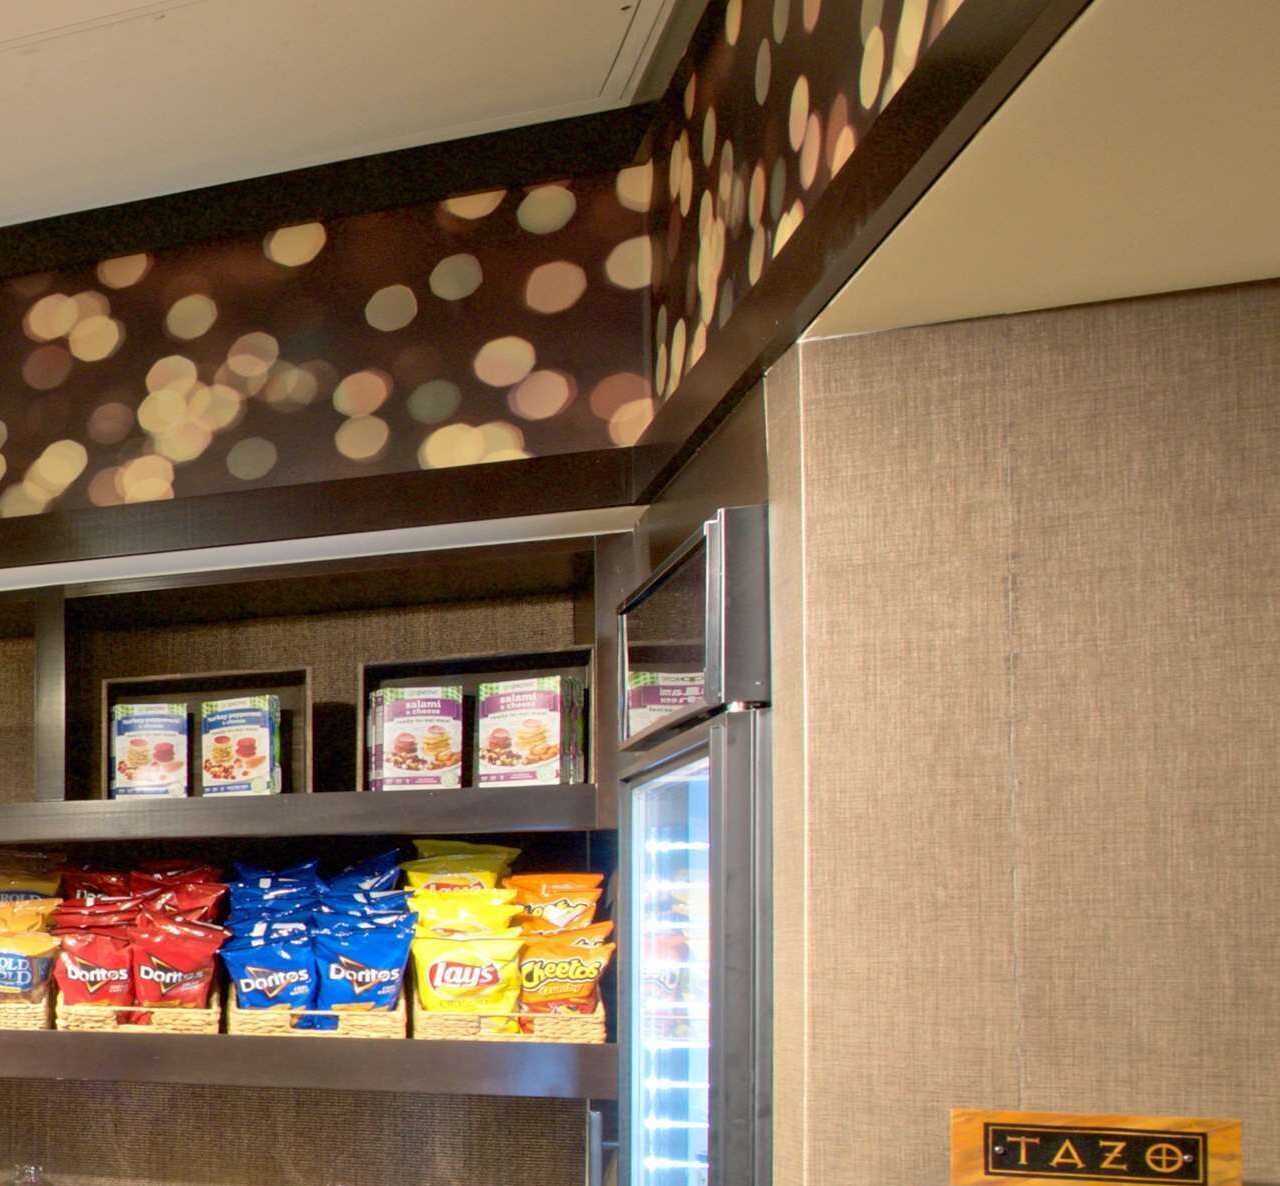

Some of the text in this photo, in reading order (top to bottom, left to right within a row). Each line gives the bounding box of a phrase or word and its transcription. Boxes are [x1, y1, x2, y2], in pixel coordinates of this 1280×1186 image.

[405, 699, 442, 709] salami
[499, 692, 537, 704] salami
[66, 964, 129, 983] Doritos
[139, 964, 205, 983] Doritos
[240, 968, 310, 993] Doritos
[329, 963, 401, 983] Doritos
[520, 959, 602, 990] Cheetos
[1006, 1135, 1184, 1174] TAZO
